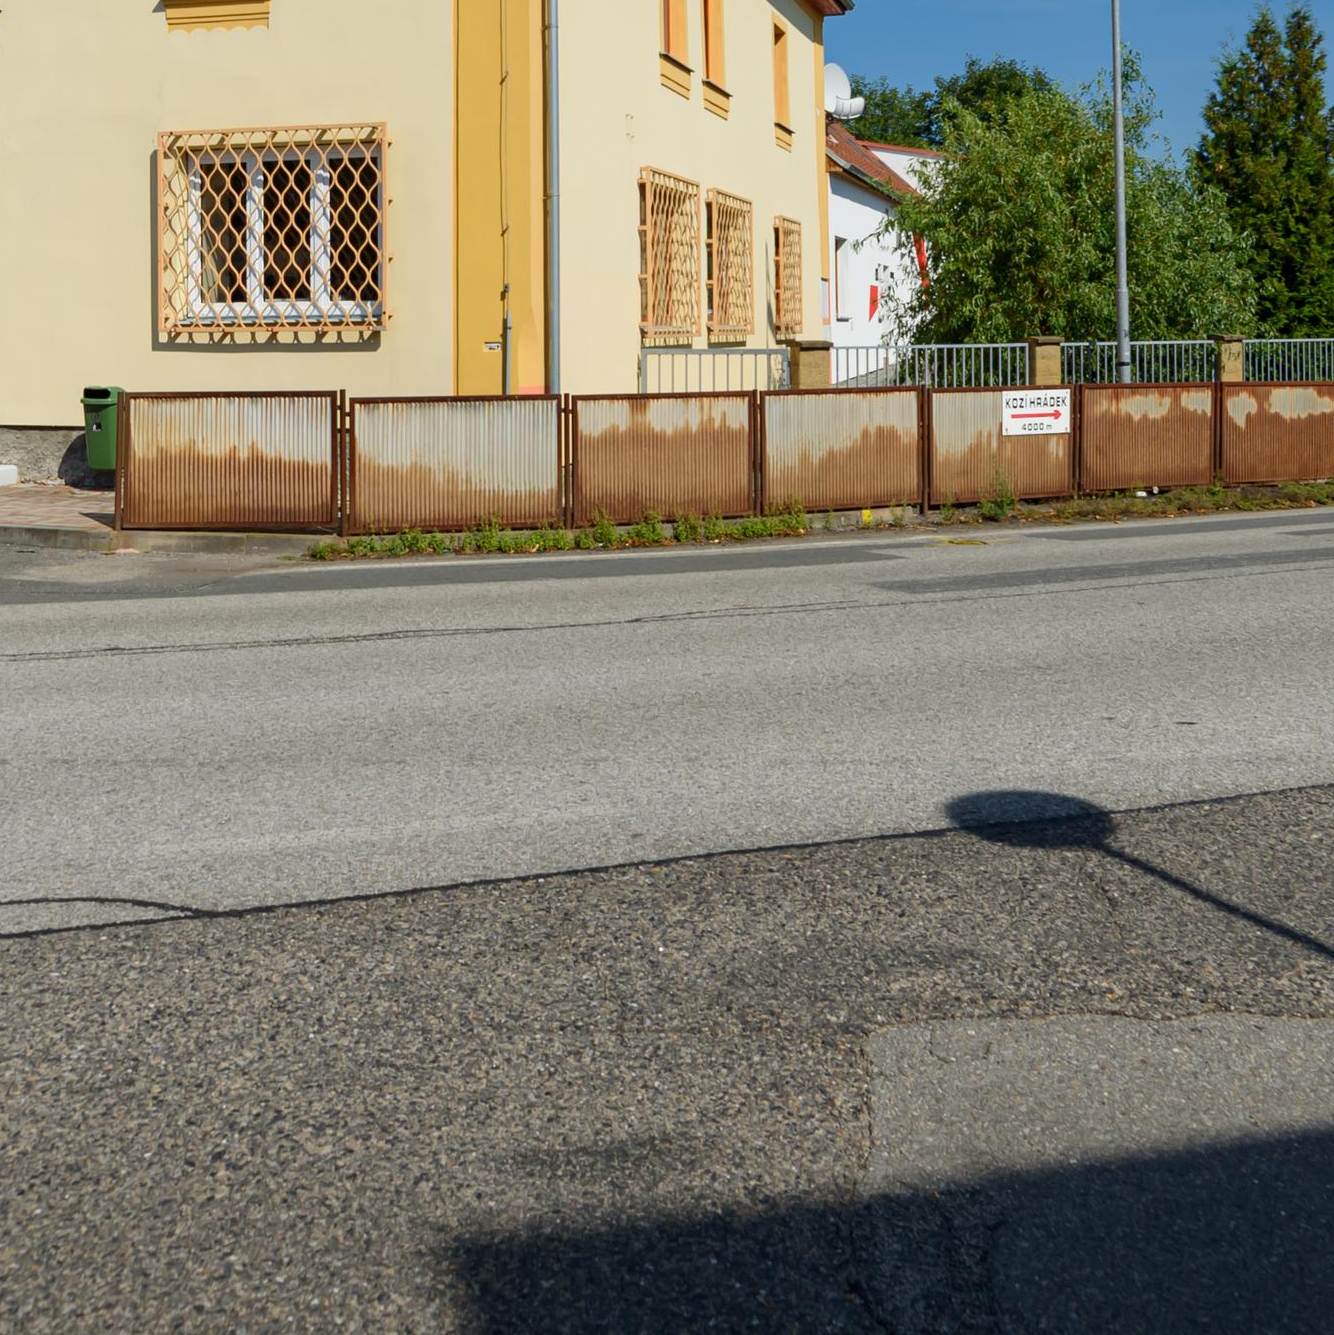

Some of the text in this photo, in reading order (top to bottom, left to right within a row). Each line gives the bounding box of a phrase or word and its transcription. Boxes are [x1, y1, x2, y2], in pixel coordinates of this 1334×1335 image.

[1005, 393, 1068, 409] KOZÍ HRÁDEK
[1022, 423, 1044, 432] 4000
